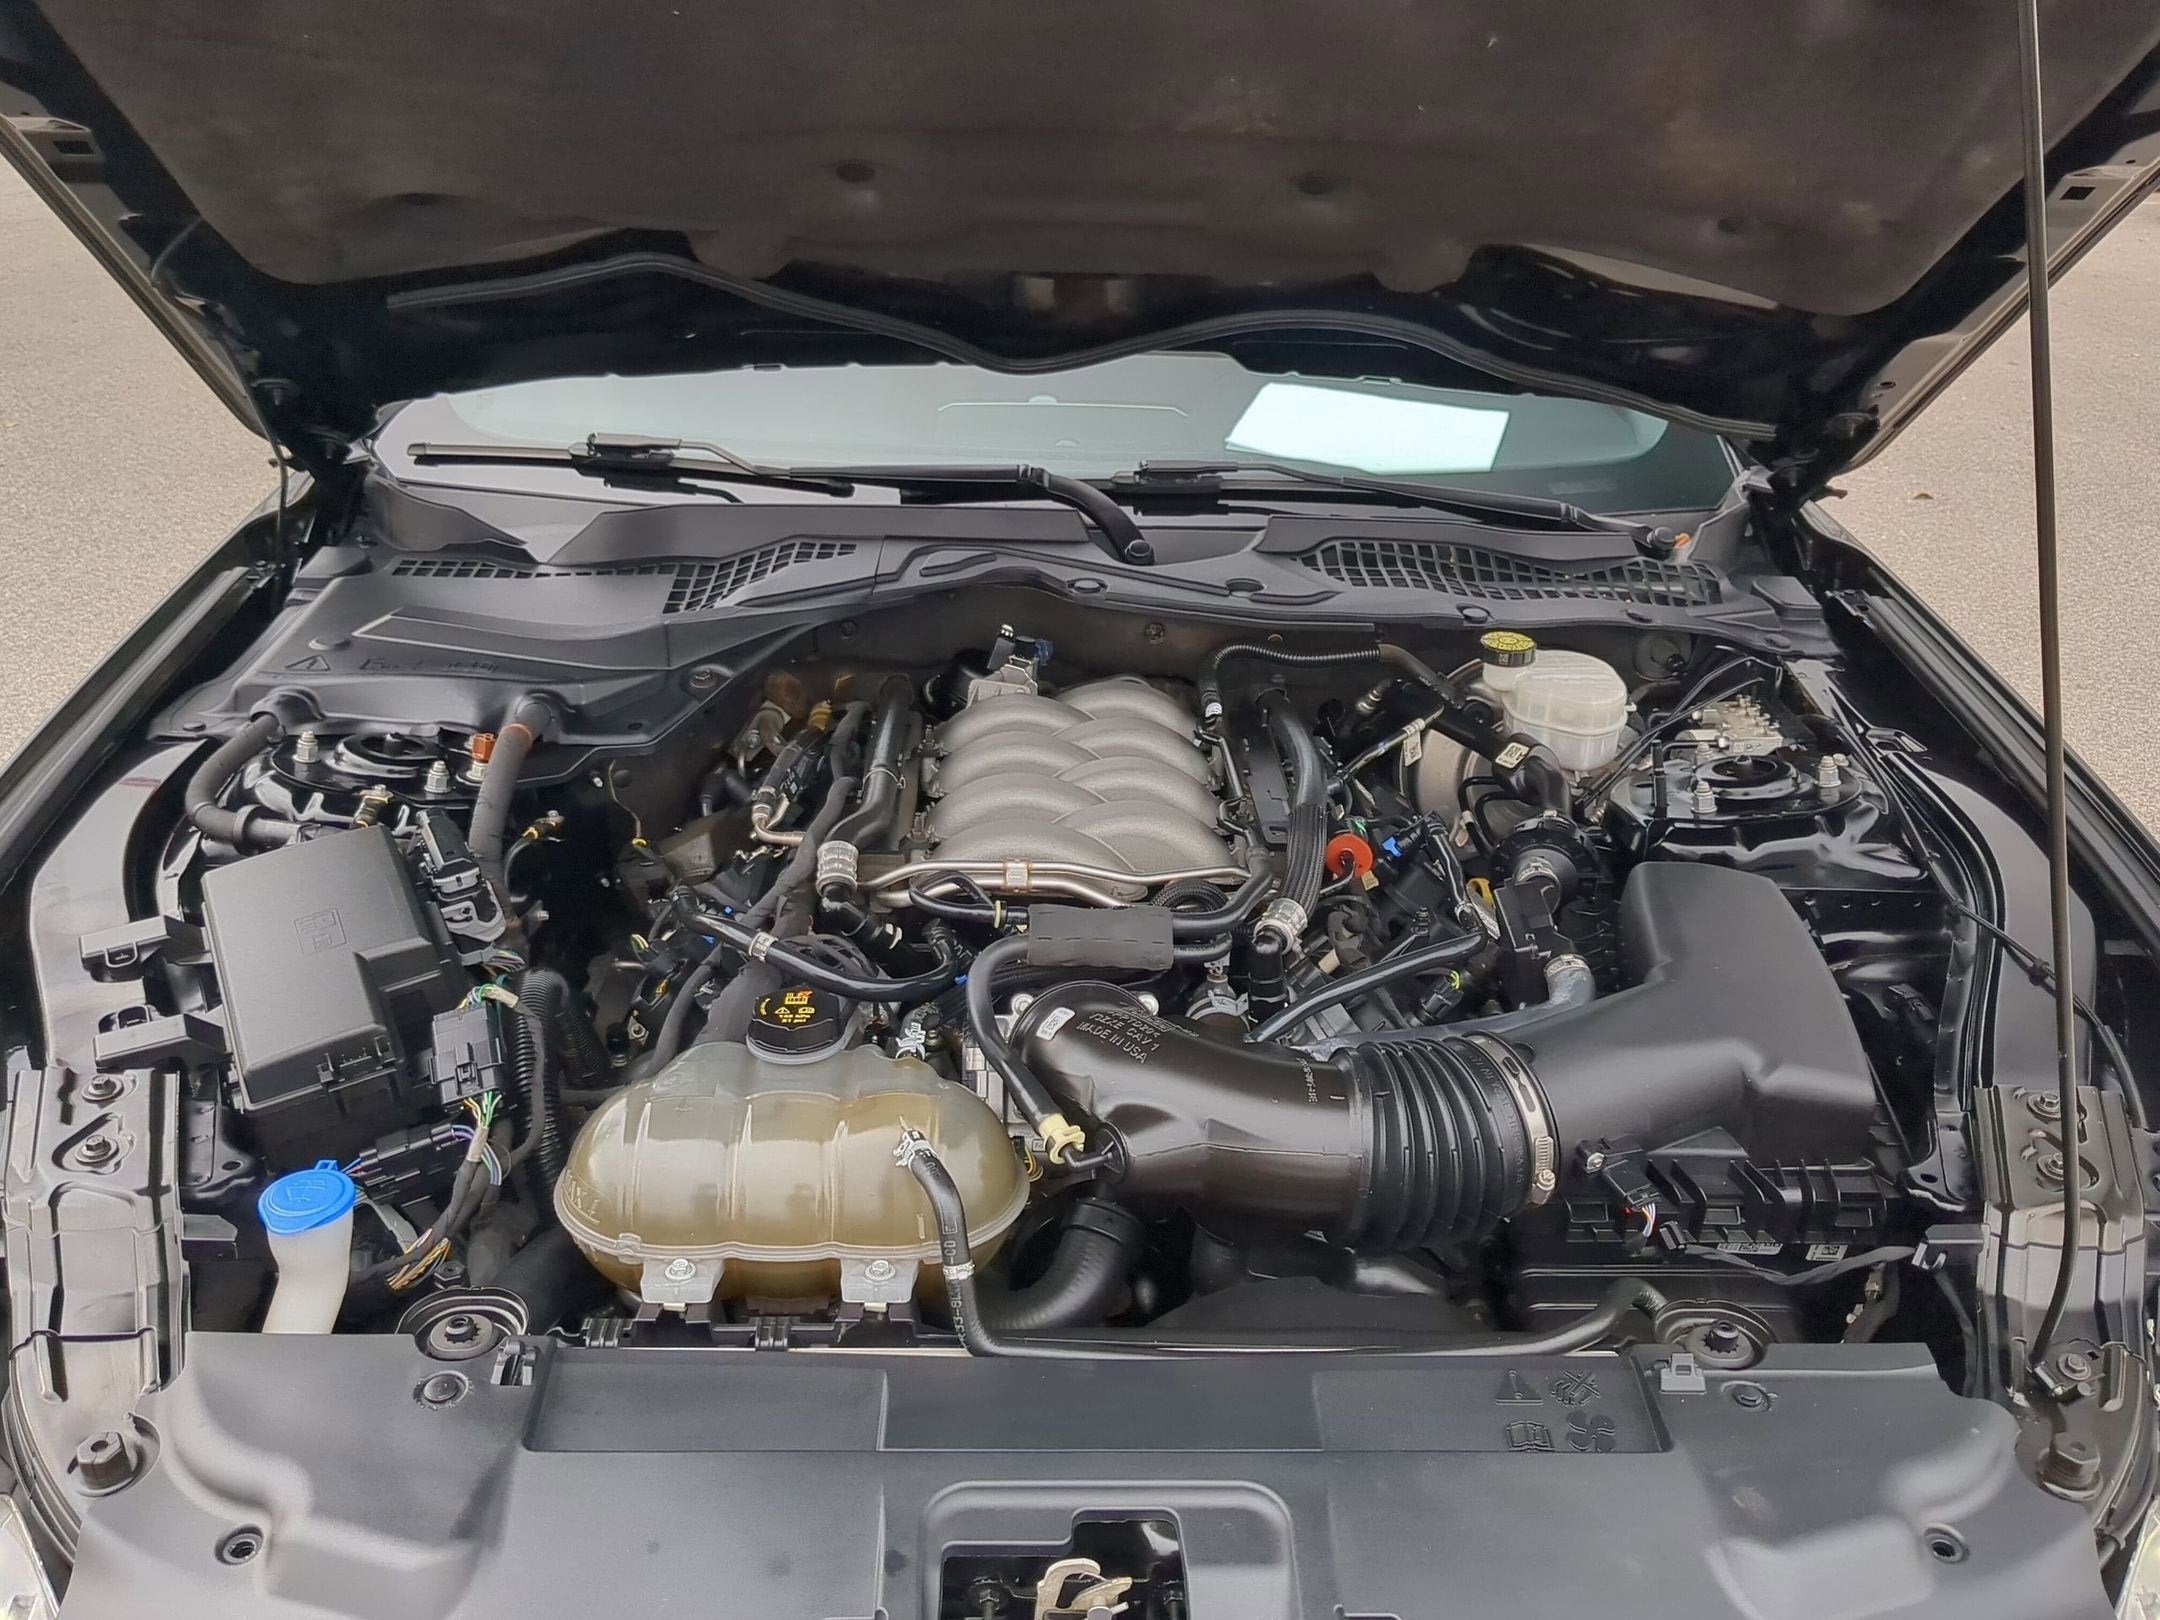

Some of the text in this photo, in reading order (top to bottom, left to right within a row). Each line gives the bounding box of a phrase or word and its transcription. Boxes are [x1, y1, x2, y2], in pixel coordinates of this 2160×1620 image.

[1076, 1020, 1112, 1040] MADE
[1108, 1033, 1124, 1047] IN
[1122, 1042, 1148, 1064] USA
